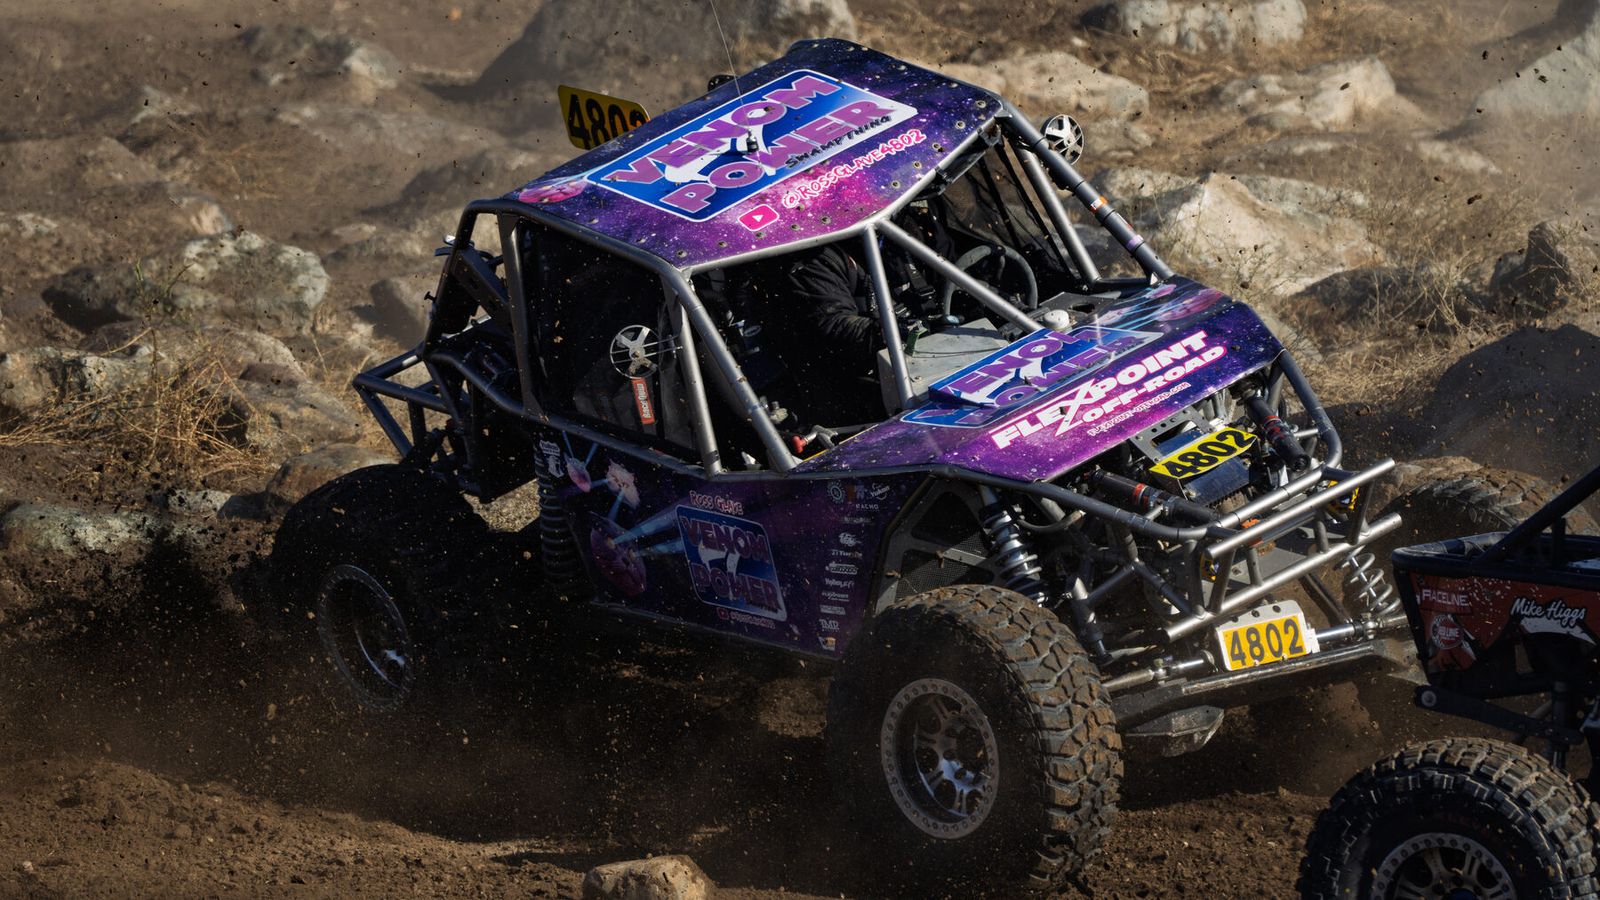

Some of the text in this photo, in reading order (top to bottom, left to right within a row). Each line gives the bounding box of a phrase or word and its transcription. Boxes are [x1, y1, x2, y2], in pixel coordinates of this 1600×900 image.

[603, 75, 842, 185] VENOM
[659, 100, 900, 213] POWER
[989, 329, 1210, 450] FLEXPOINT
[1081, 345, 1229, 425] OFF-ROAD
[1162, 431, 1254, 478] 4802
[680, 515, 770, 563] VENOM
[691, 562, 782, 611] POWER
[1510, 598, 1586, 626] Mike Higgs
[1230, 618, 1304, 666] 4802
